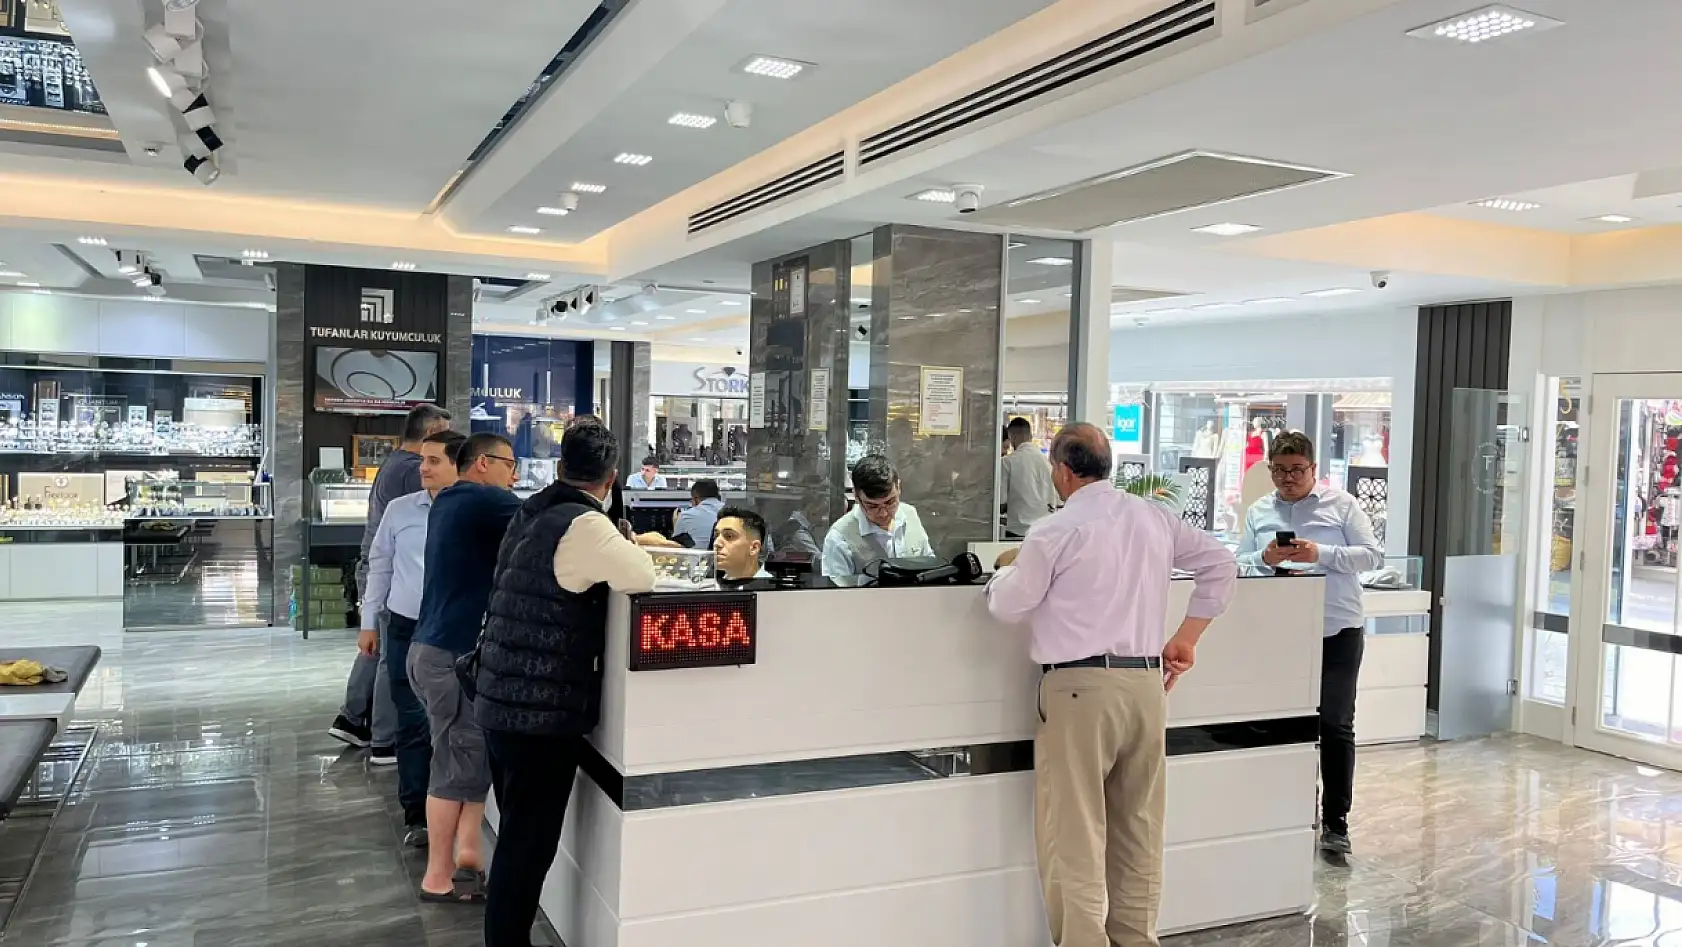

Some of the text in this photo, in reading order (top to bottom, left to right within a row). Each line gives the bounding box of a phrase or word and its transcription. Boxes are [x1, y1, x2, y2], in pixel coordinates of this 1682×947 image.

[310, 326, 441, 343] TUFANLAR KUYUMCULUK
[641, 611, 751, 650] KASA
